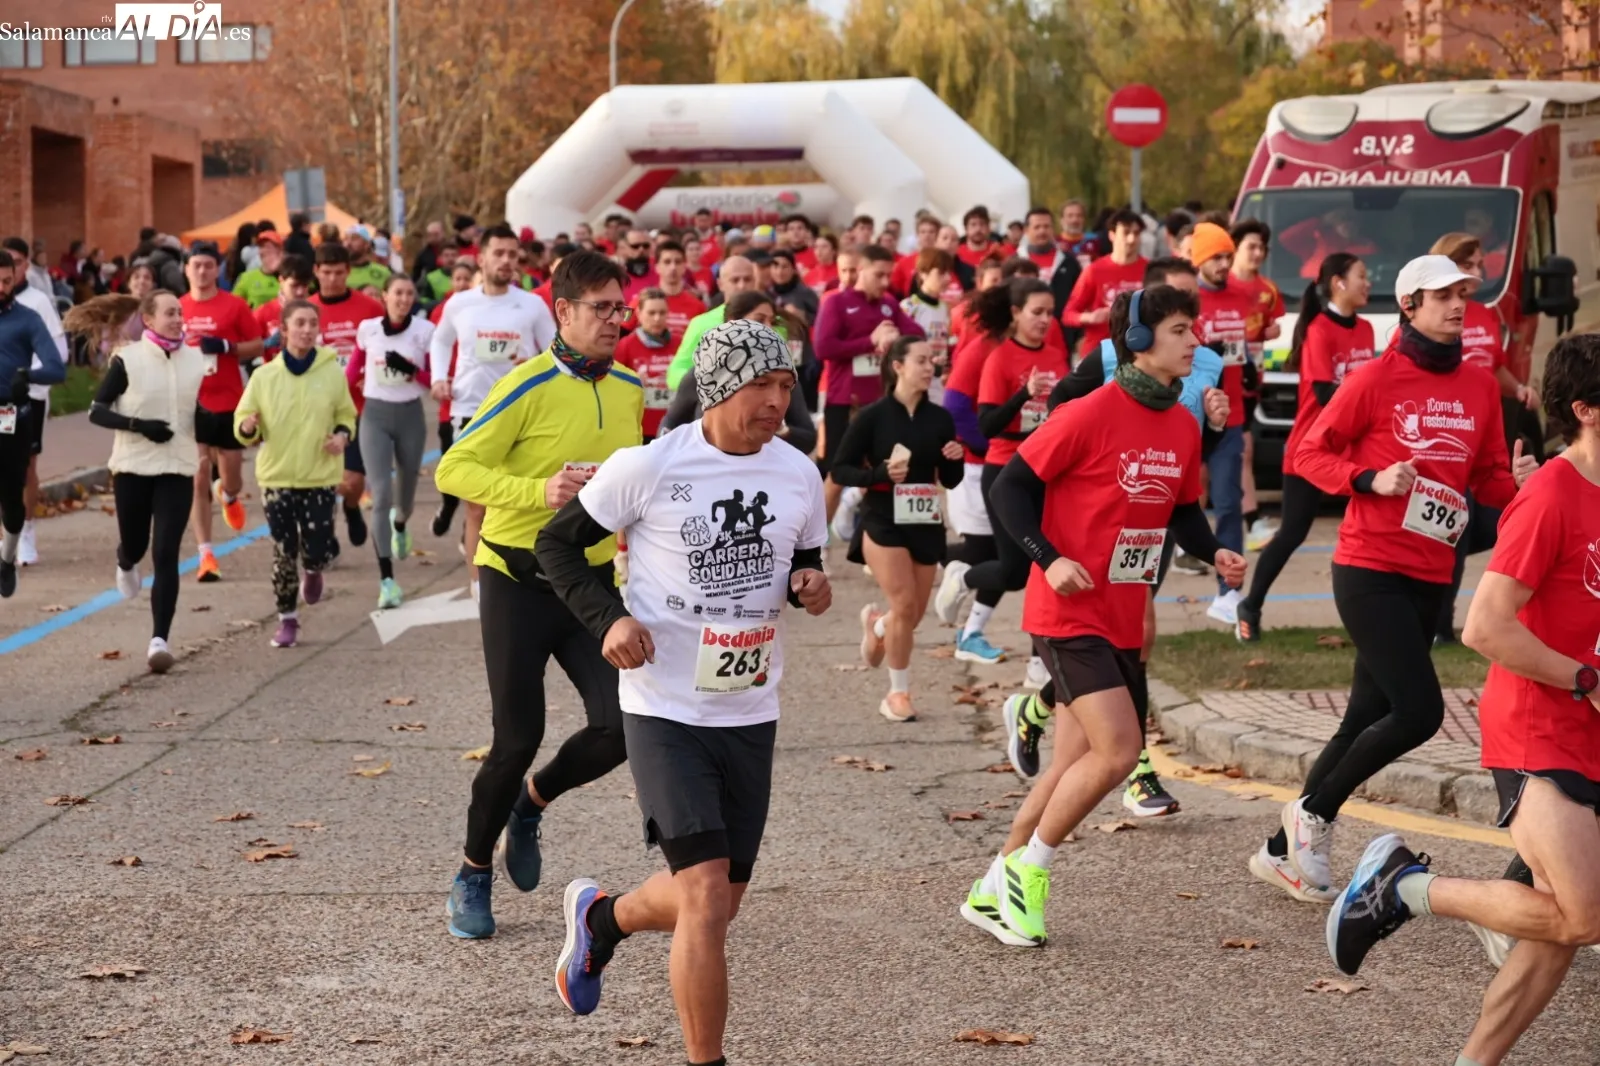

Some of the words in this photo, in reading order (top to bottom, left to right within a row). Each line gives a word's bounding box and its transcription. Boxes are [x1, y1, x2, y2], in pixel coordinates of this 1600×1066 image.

[490, 340, 508, 353] 87
[907, 497, 934, 513] 102
[1421, 500, 1459, 530] 396
[683, 515, 708, 534] 5K
[682, 530, 712, 547] 10K
[717, 530, 733, 543] 3K
[1117, 532, 1164, 546] bedunia
[688, 540, 774, 568] CARRERA
[1120, 548, 1150, 568] 351
[688, 555, 775, 585] SOLIDARIA
[705, 590, 731, 598] MEMORIAL
[733, 586, 754, 594] CARMELO
[706, 606, 727, 614] ALCER
[702, 625, 776, 649] bedunia
[716, 647, 761, 677] 263
